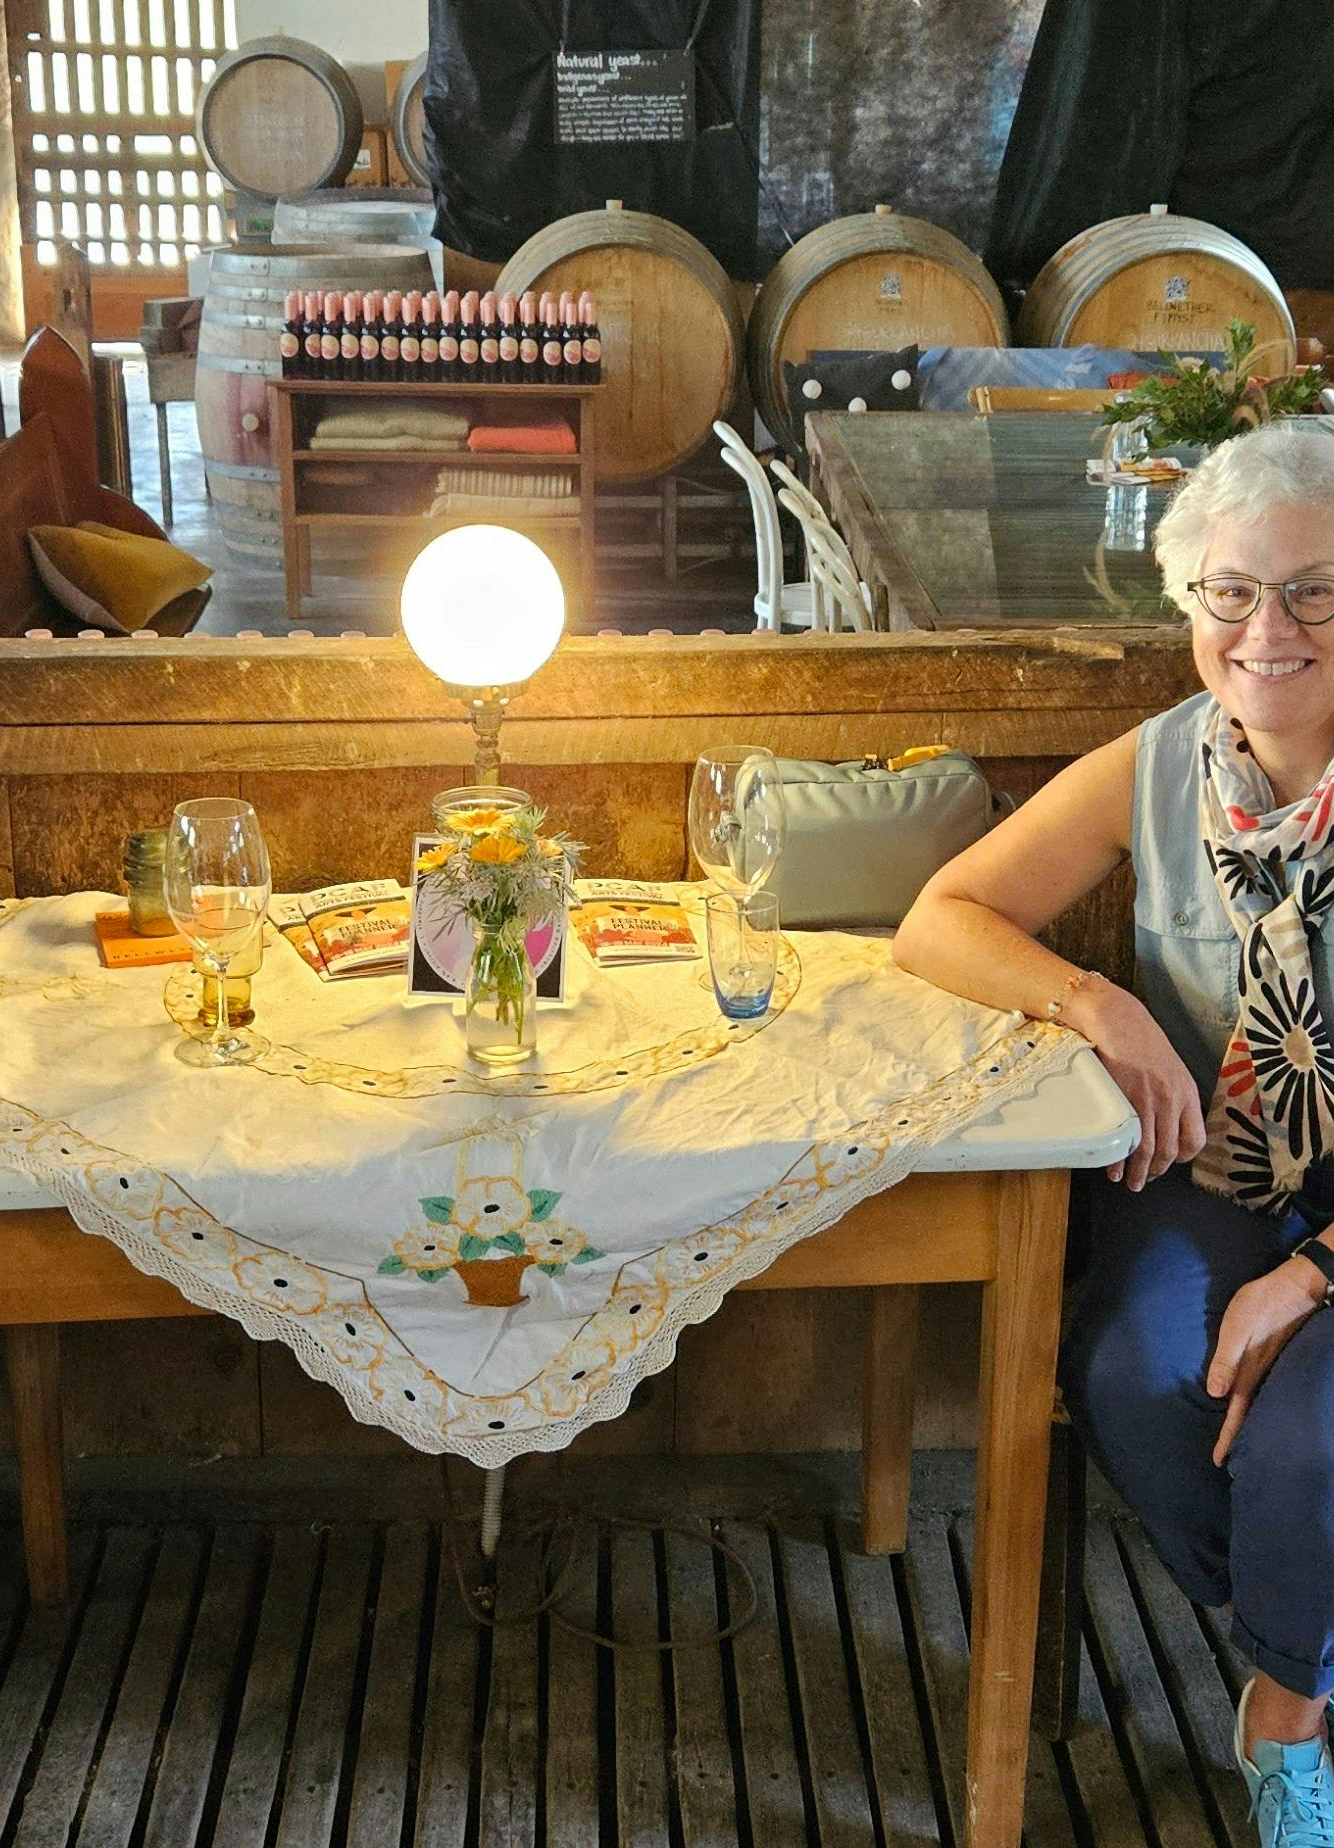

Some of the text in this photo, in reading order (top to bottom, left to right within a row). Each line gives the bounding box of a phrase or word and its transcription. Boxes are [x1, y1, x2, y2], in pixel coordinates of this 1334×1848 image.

[556, 53, 603, 69] Natural
[338, 918, 391, 933] FESTIVAL
[610, 917, 662, 926] FESTIVAL
[612, 923, 668, 932] PLANNER
